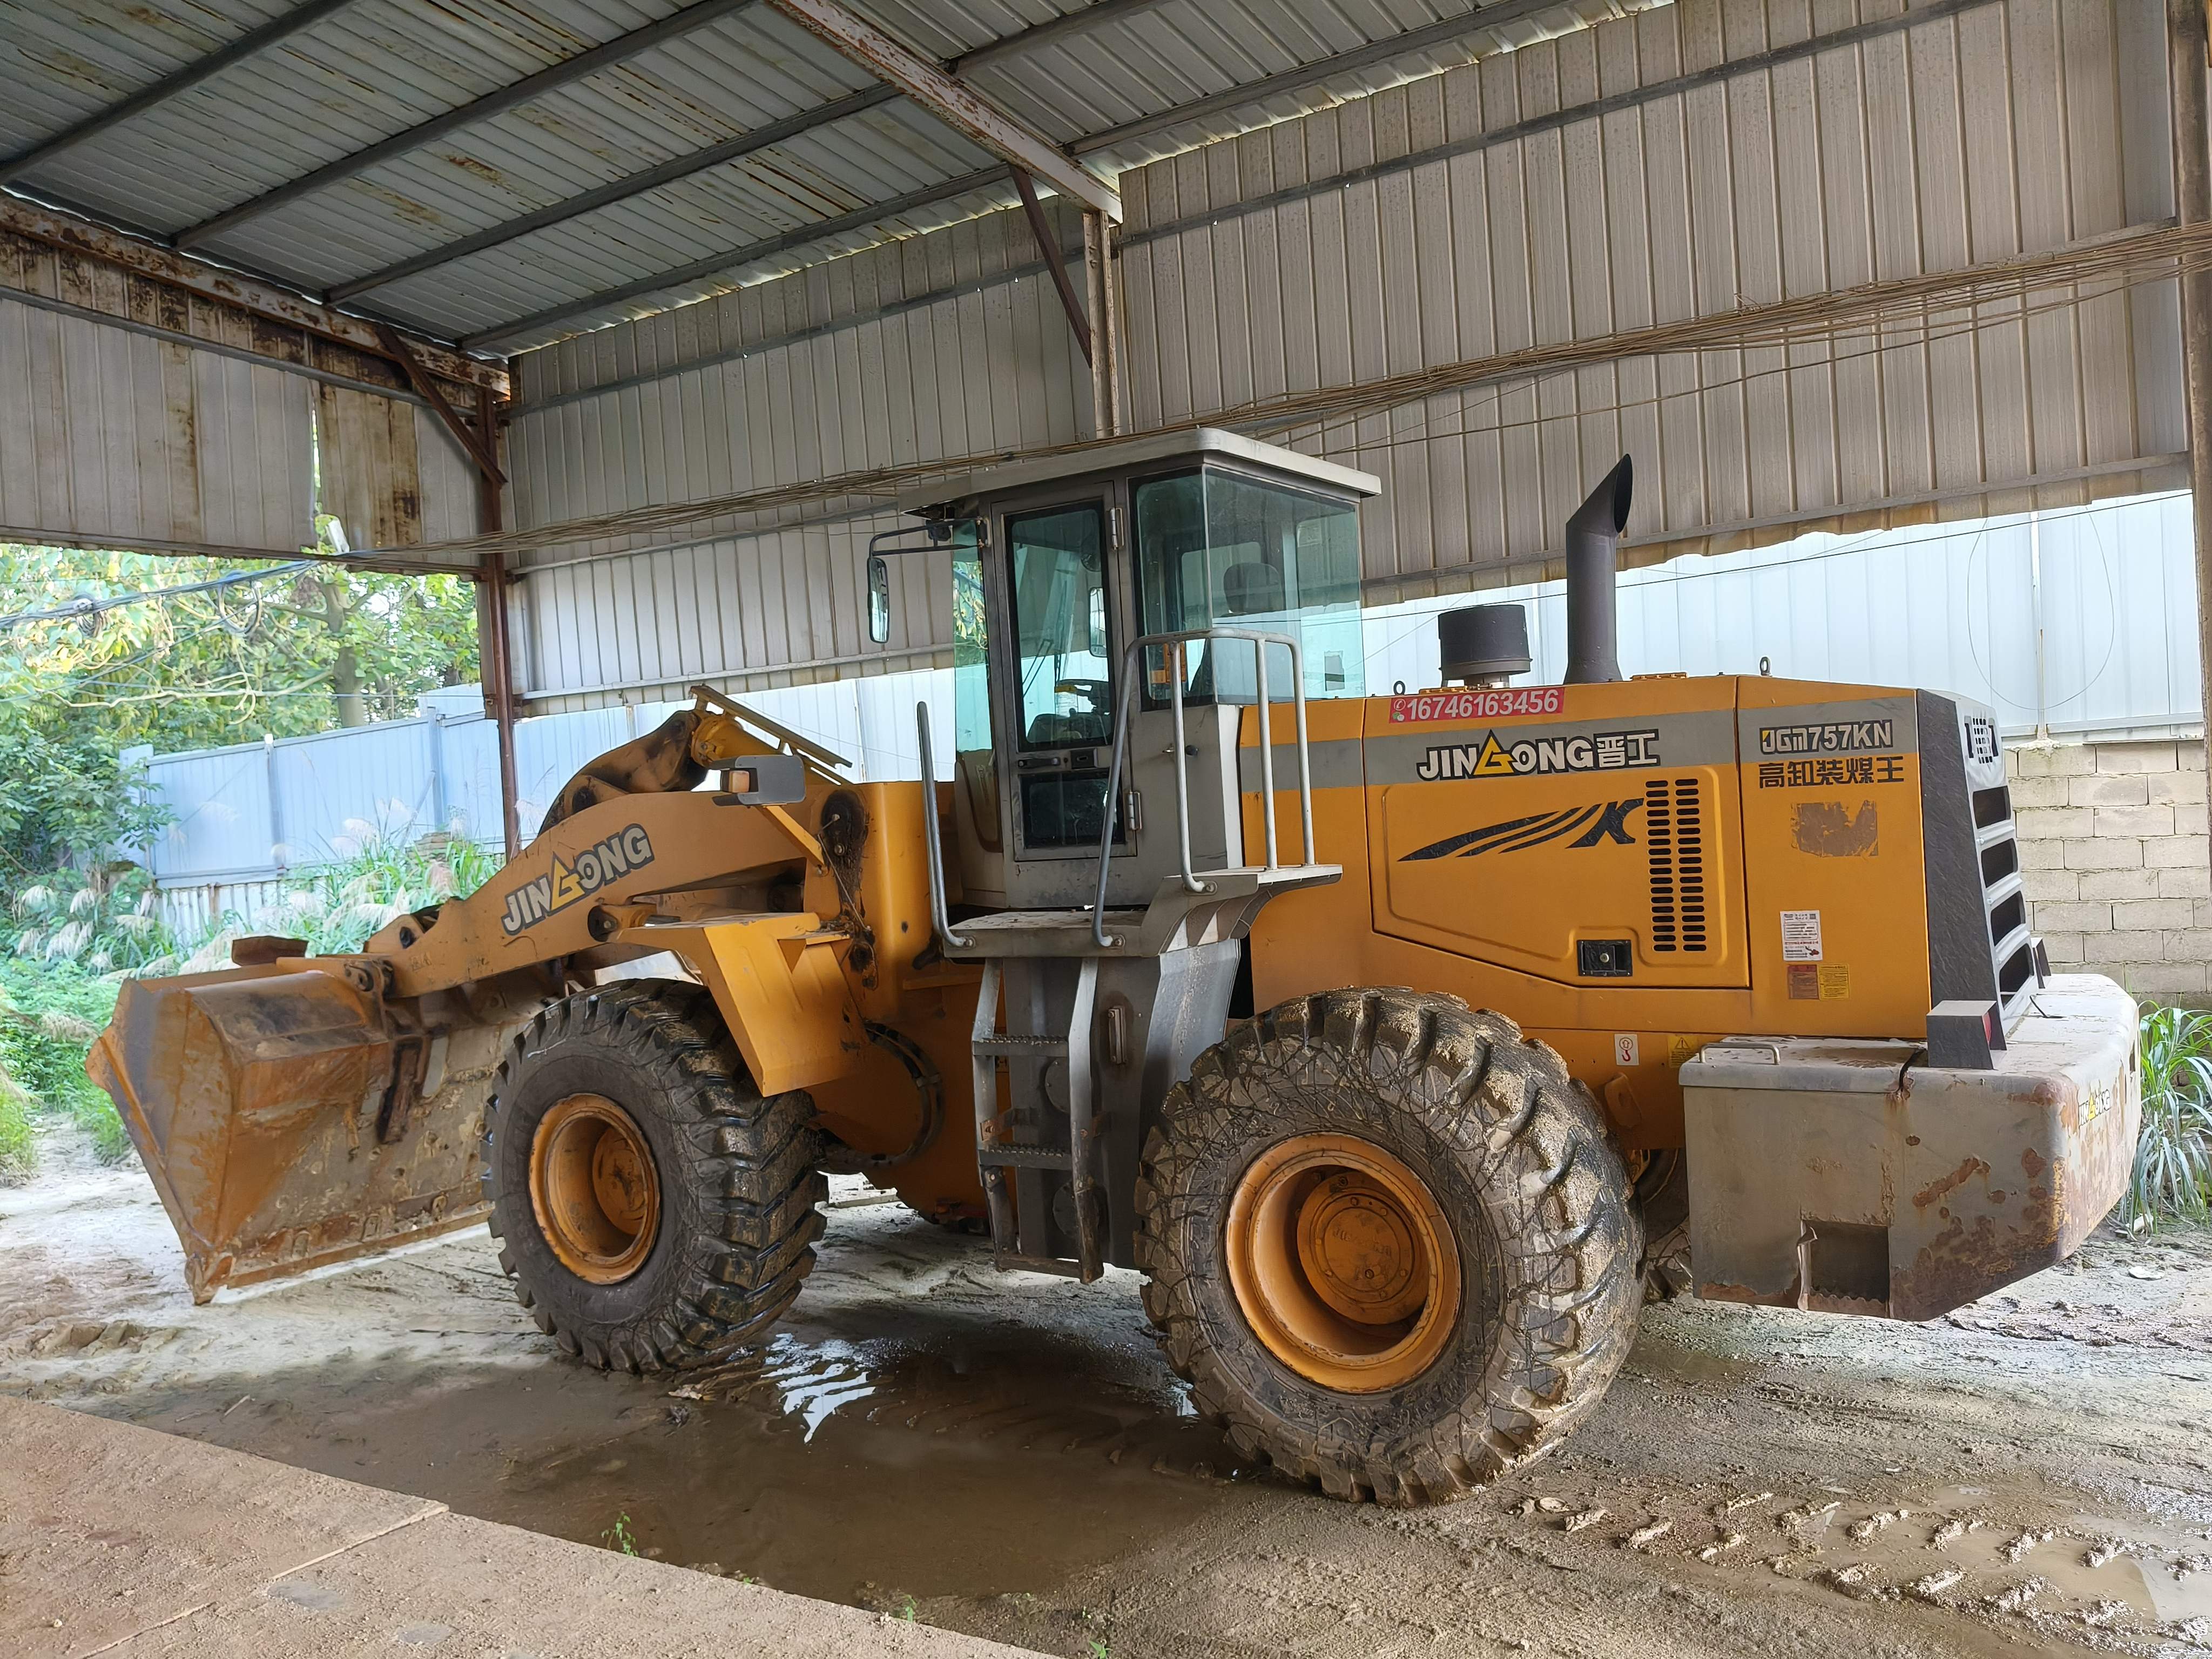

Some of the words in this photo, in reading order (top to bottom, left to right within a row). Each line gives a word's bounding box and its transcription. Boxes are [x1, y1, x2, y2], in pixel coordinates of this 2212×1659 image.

[1407, 689, 1559, 721] 16746163456
[1759, 756, 1905, 788] 高卸装煤王
[502, 825, 653, 934] JINGONG
